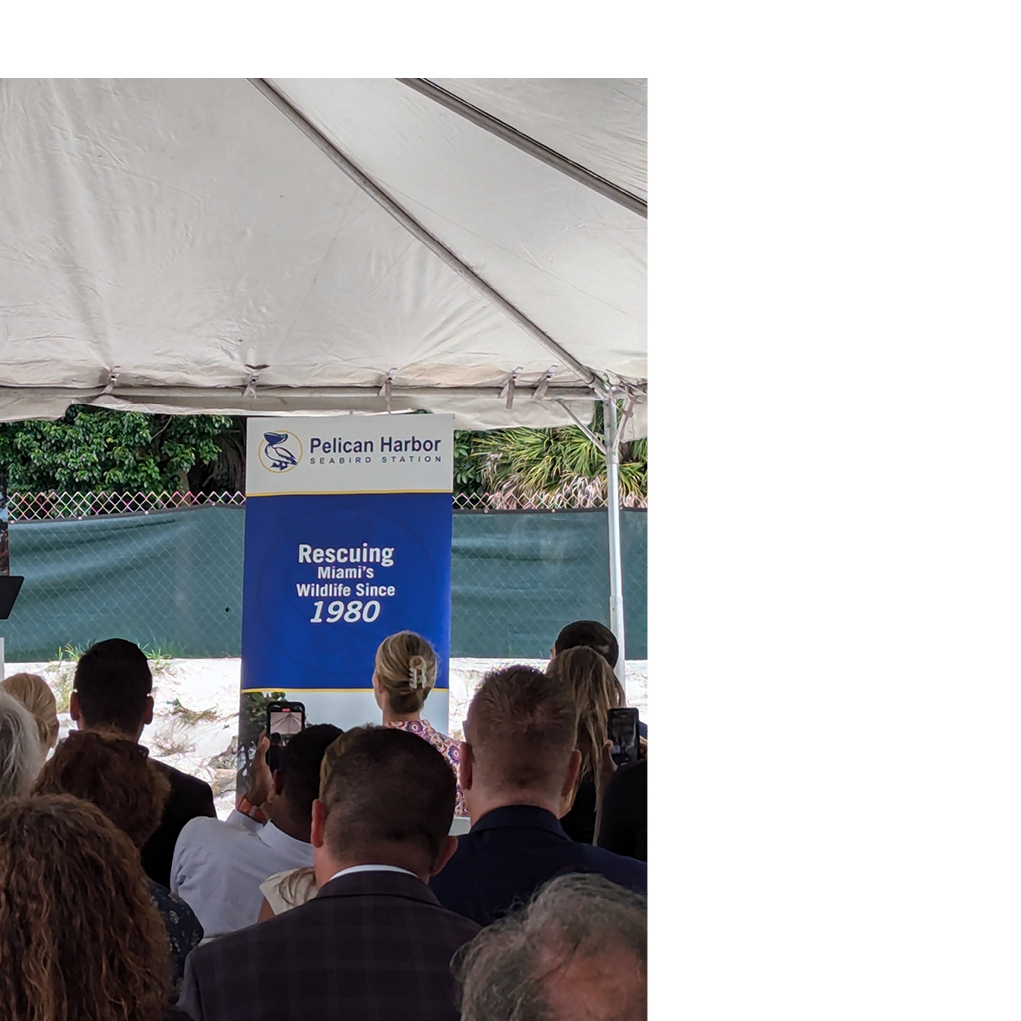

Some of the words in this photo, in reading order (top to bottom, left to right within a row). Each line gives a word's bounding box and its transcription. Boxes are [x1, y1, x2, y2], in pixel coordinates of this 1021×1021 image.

[310, 437, 374, 454] Pelican
[380, 436, 442, 452] Harbor
[298, 542, 395, 567] Rescuing
[317, 565, 375, 579] Miami's
[296, 583, 352, 597] Wildlife
[355, 582, 396, 597] Since
[310, 600, 381, 623] 1980
